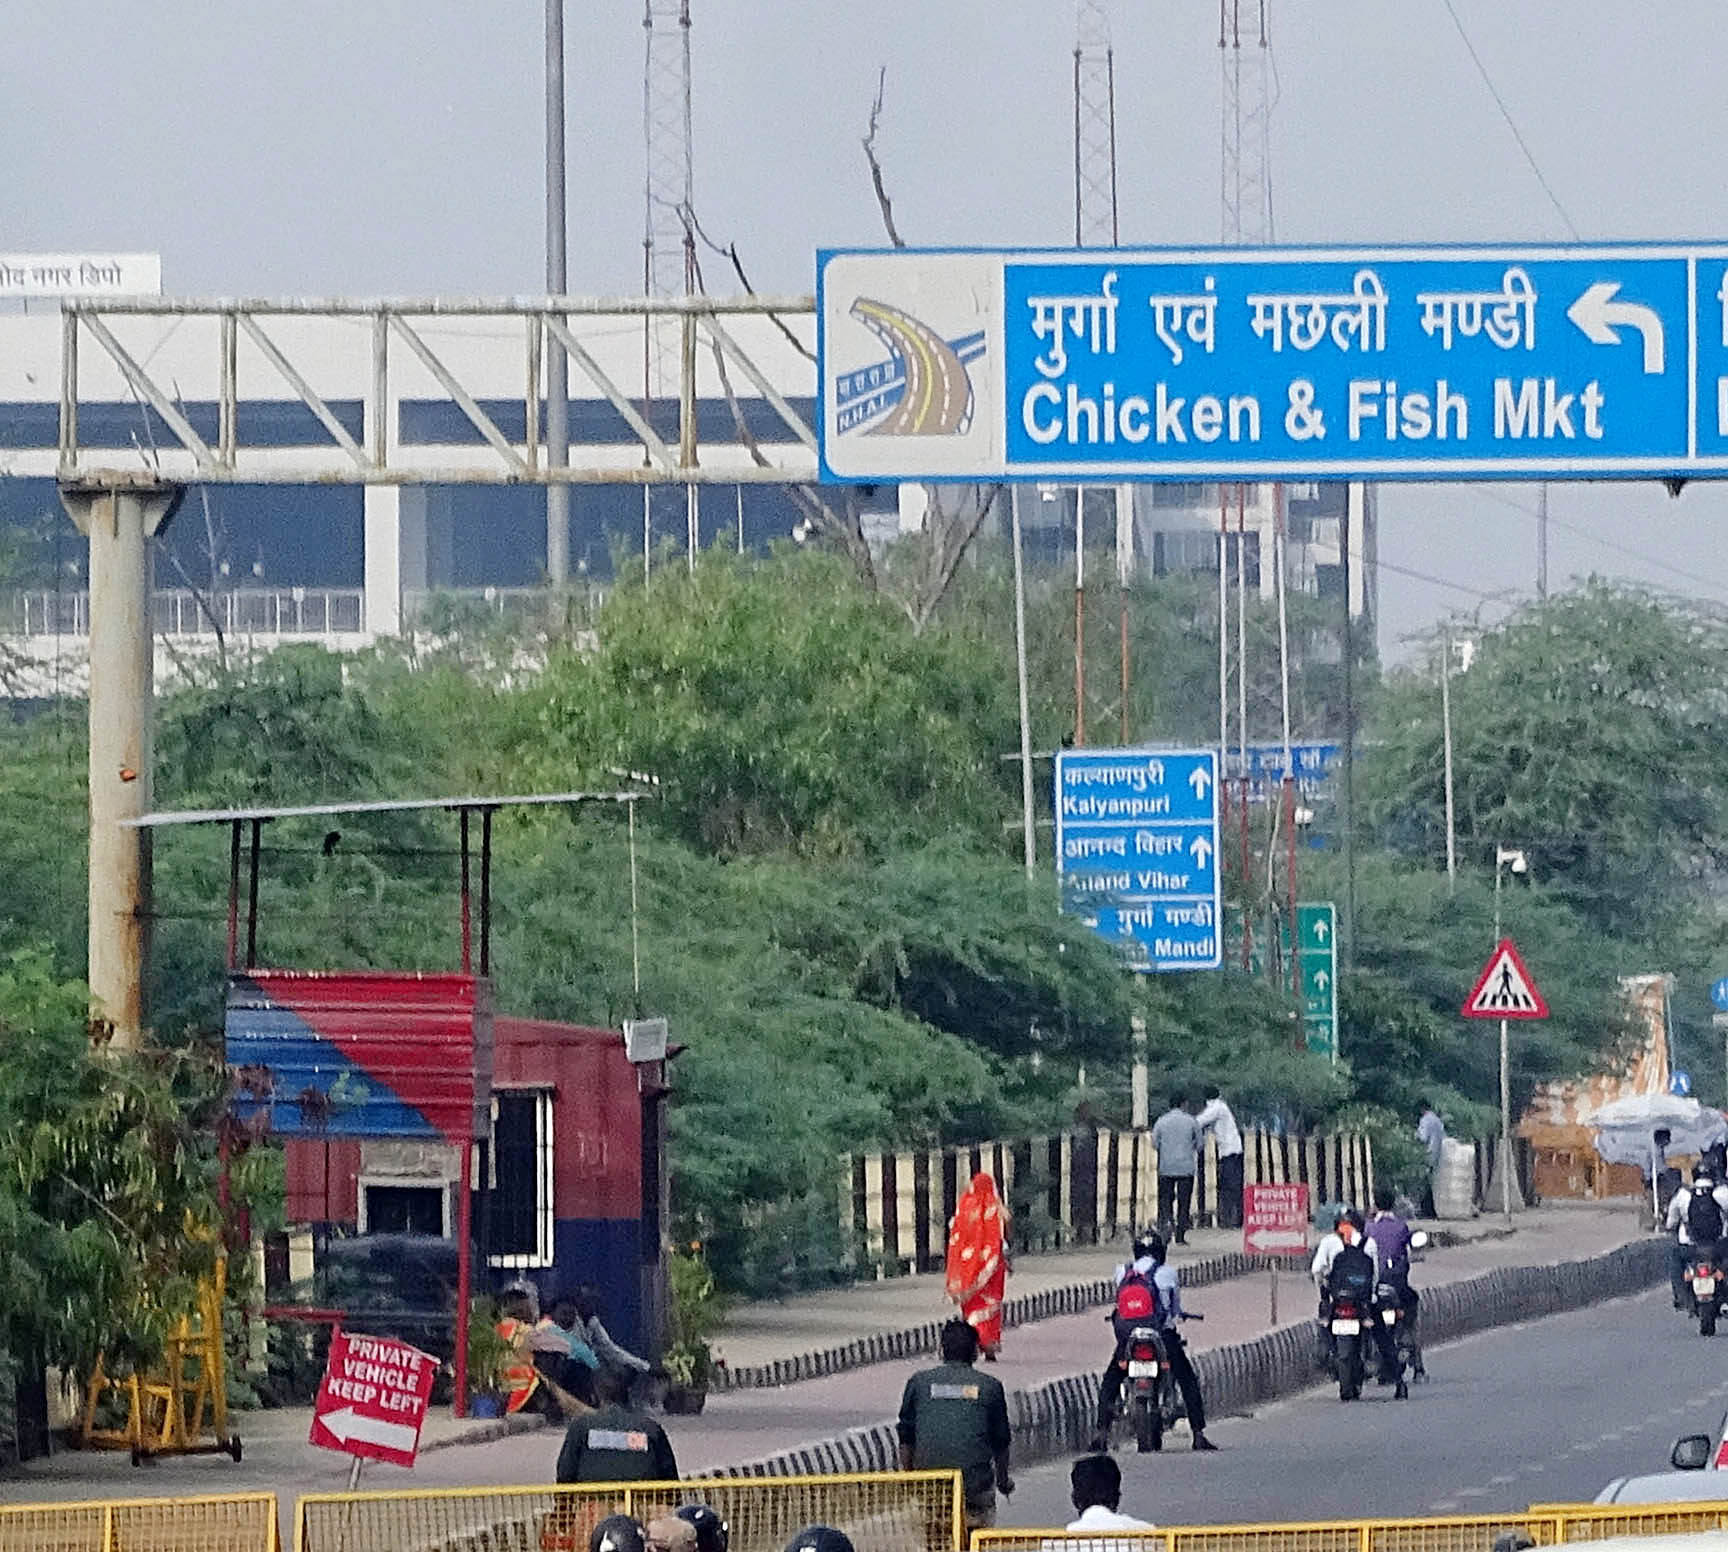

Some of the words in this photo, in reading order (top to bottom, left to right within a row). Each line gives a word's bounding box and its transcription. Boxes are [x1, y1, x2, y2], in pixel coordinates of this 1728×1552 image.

[31, 266, 72, 287] नगर
[1027, 271, 1118, 378] मुर्गा
[1151, 279, 1218, 365] एवं
[1247, 270, 1390, 354] मछली
[1418, 266, 1539, 352] मण्डी
[1023, 378, 1262, 446] Chicken
[1285, 382, 1327, 441] &
[1348, 373, 1470, 441] Fish
[1494, 374, 1605, 441] Mkt
[1064, 758, 1165, 792] कल्याणपुरी
[1063, 793, 1171, 818] Kalyanpuri
[1135, 829, 1183, 857] विहार
[1137, 870, 1191, 890] Vihar
[1164, 902, 1213, 928] मण्डी
[1154, 936, 1215, 958] Mandi
[1253, 1200, 1298, 1213] VEHICLE
[1254, 1188, 1298, 1201] PRIVATE
[1247, 1213, 1277, 1226] KEEP
[348, 1338, 423, 1372] PRIVATE
[344, 1357, 420, 1393] VEHICLE
[327, 1376, 377, 1404] KEEP
[380, 1389, 423, 1416] LEFT
